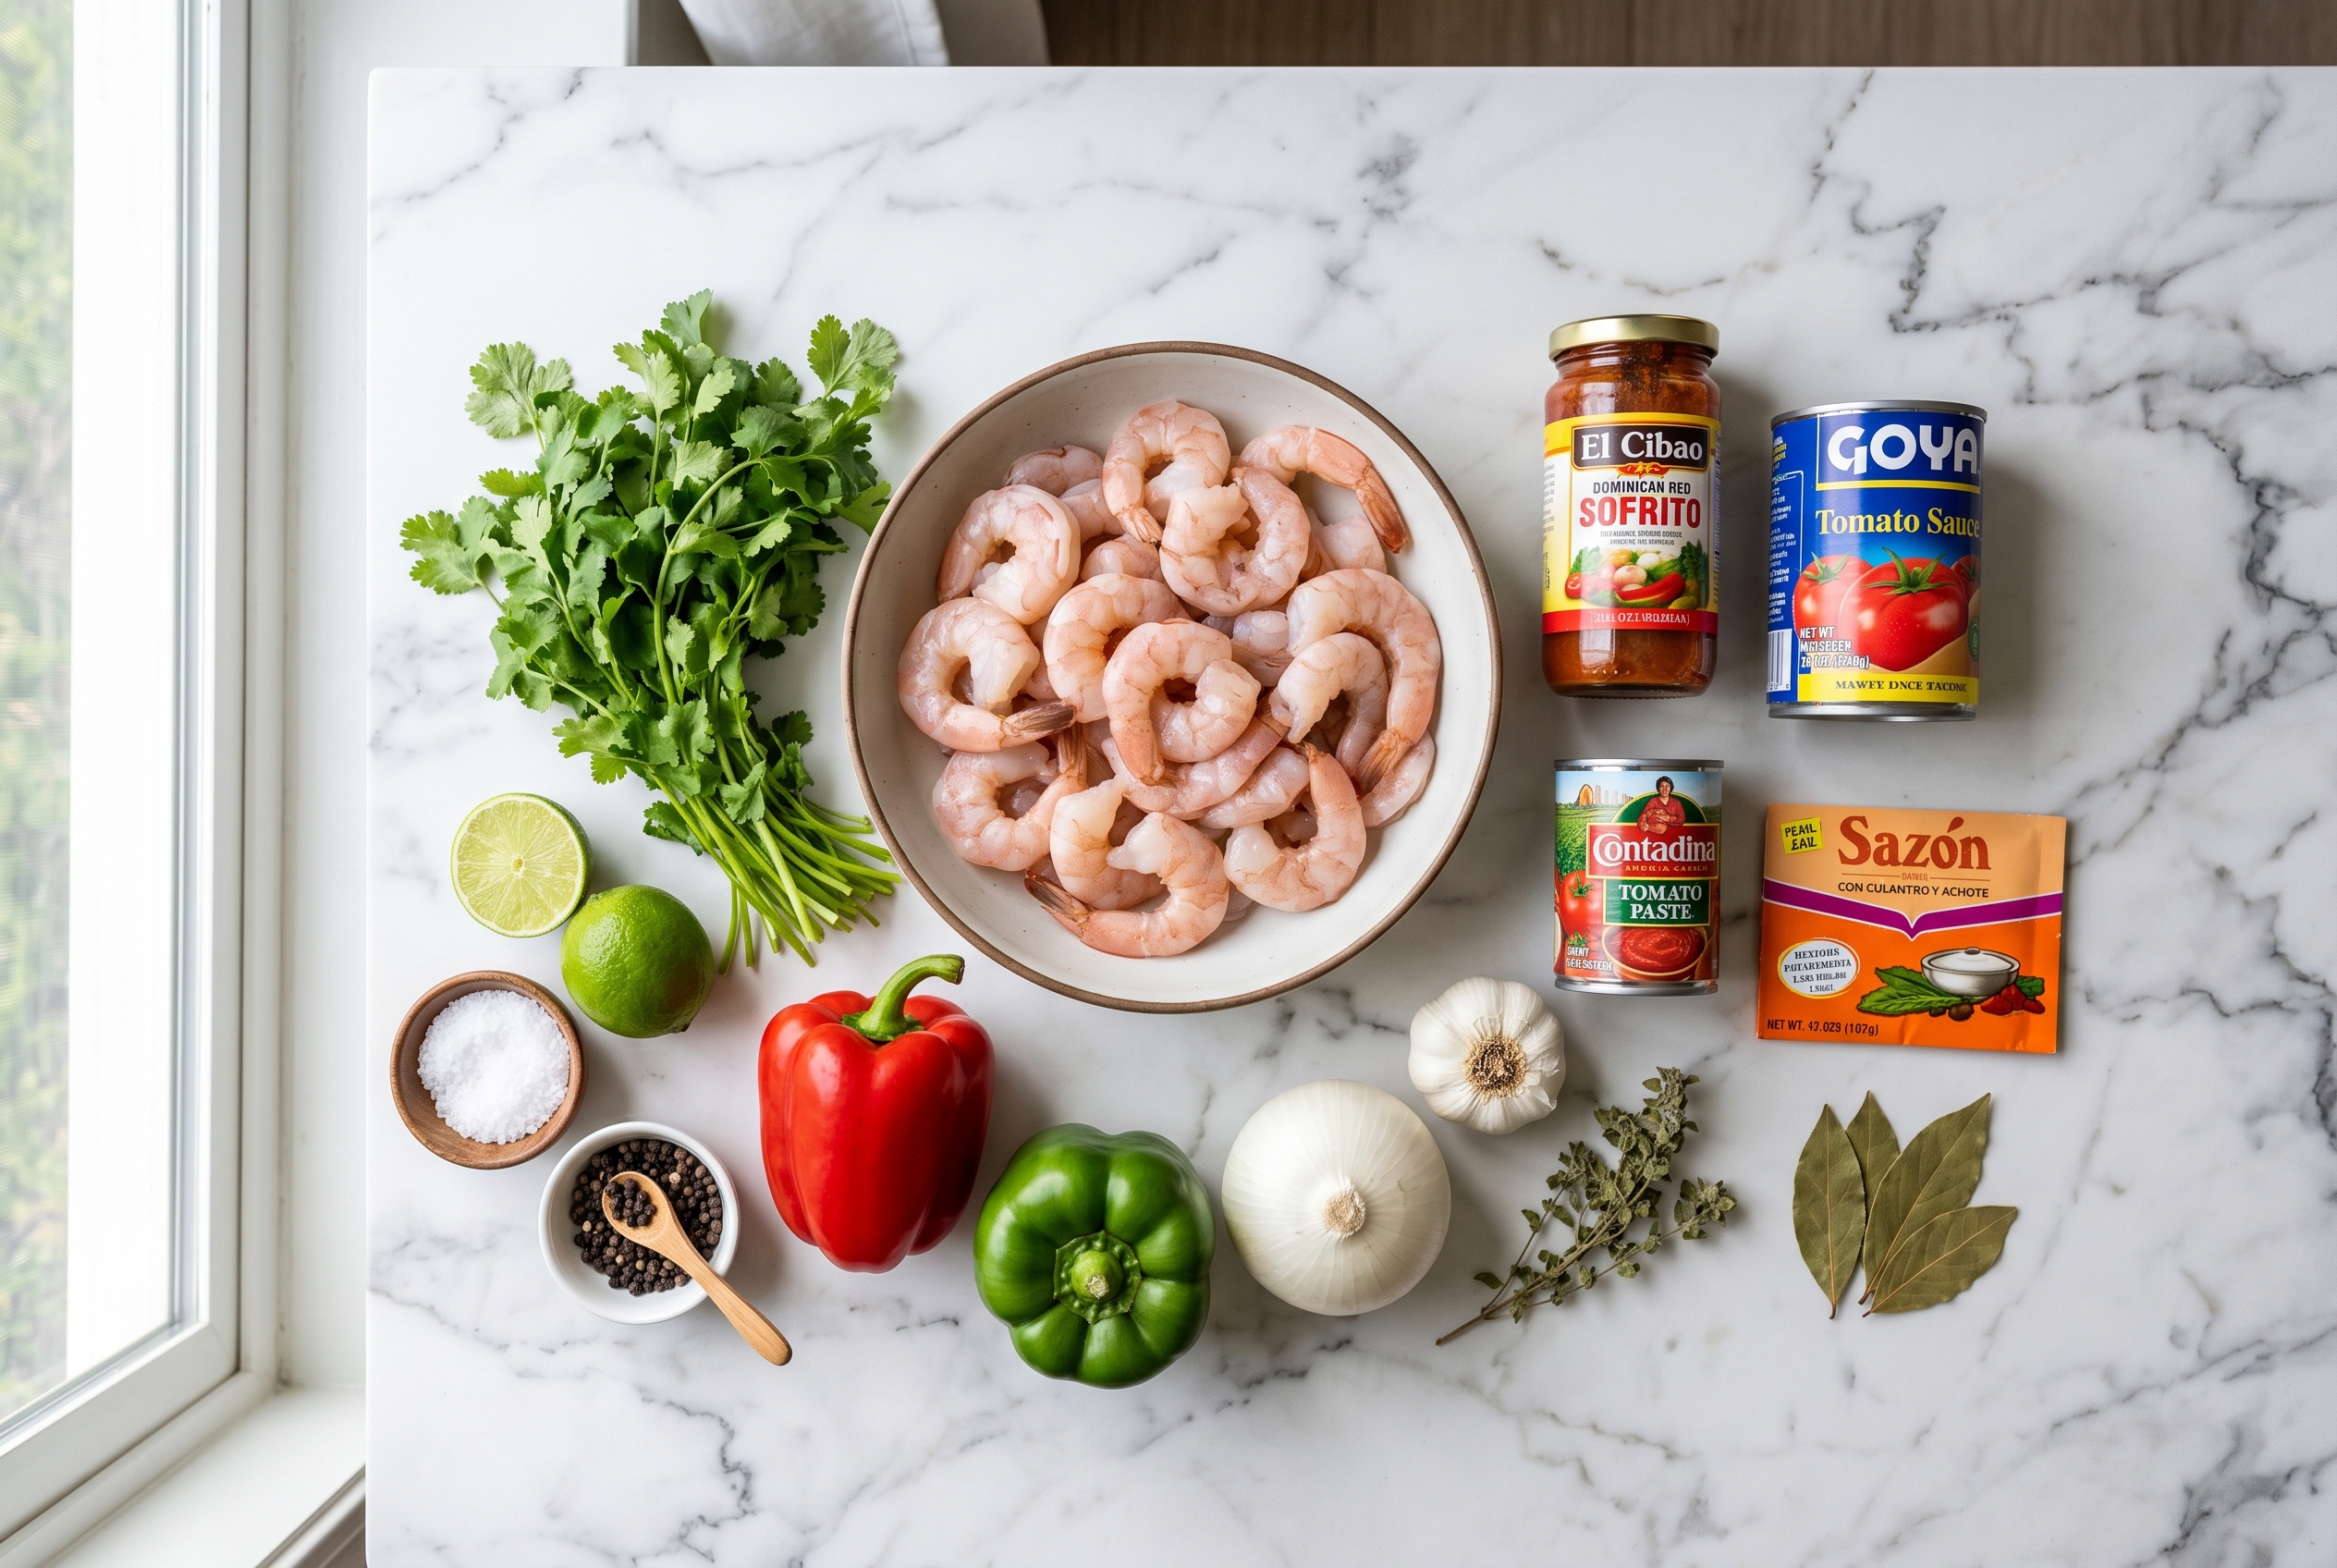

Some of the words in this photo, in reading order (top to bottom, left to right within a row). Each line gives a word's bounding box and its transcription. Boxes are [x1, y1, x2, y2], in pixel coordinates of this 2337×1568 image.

[1581, 432, 1611, 460] El
[1621, 432, 1703, 460] Cibao
[1828, 423, 1977, 474] GOYA
[1593, 481, 1664, 495] DOMINICAN
[1669, 482, 1691, 495] RED
[1580, 496, 1701, 528] SOFRITO
[1816, 508, 1920, 535] Tomato
[1927, 508, 1980, 538] Sauce
[1800, 627, 1817, 639] NET
[1818, 626, 1835, 638] WT
[1593, 833, 1716, 867] Contadina
[1838, 815, 1991, 870] Sazón
[1618, 885, 1703, 901] TOMATO
[1838, 882, 1864, 892] CON
[1866, 883, 1930, 895] CULANTRO
[1931, 886, 1939, 896] Y
[1941, 887, 1989, 898] ACHOTE
[1767, 1019, 1785, 1030] NET
[1787, 1020, 1805, 1031] WT.
